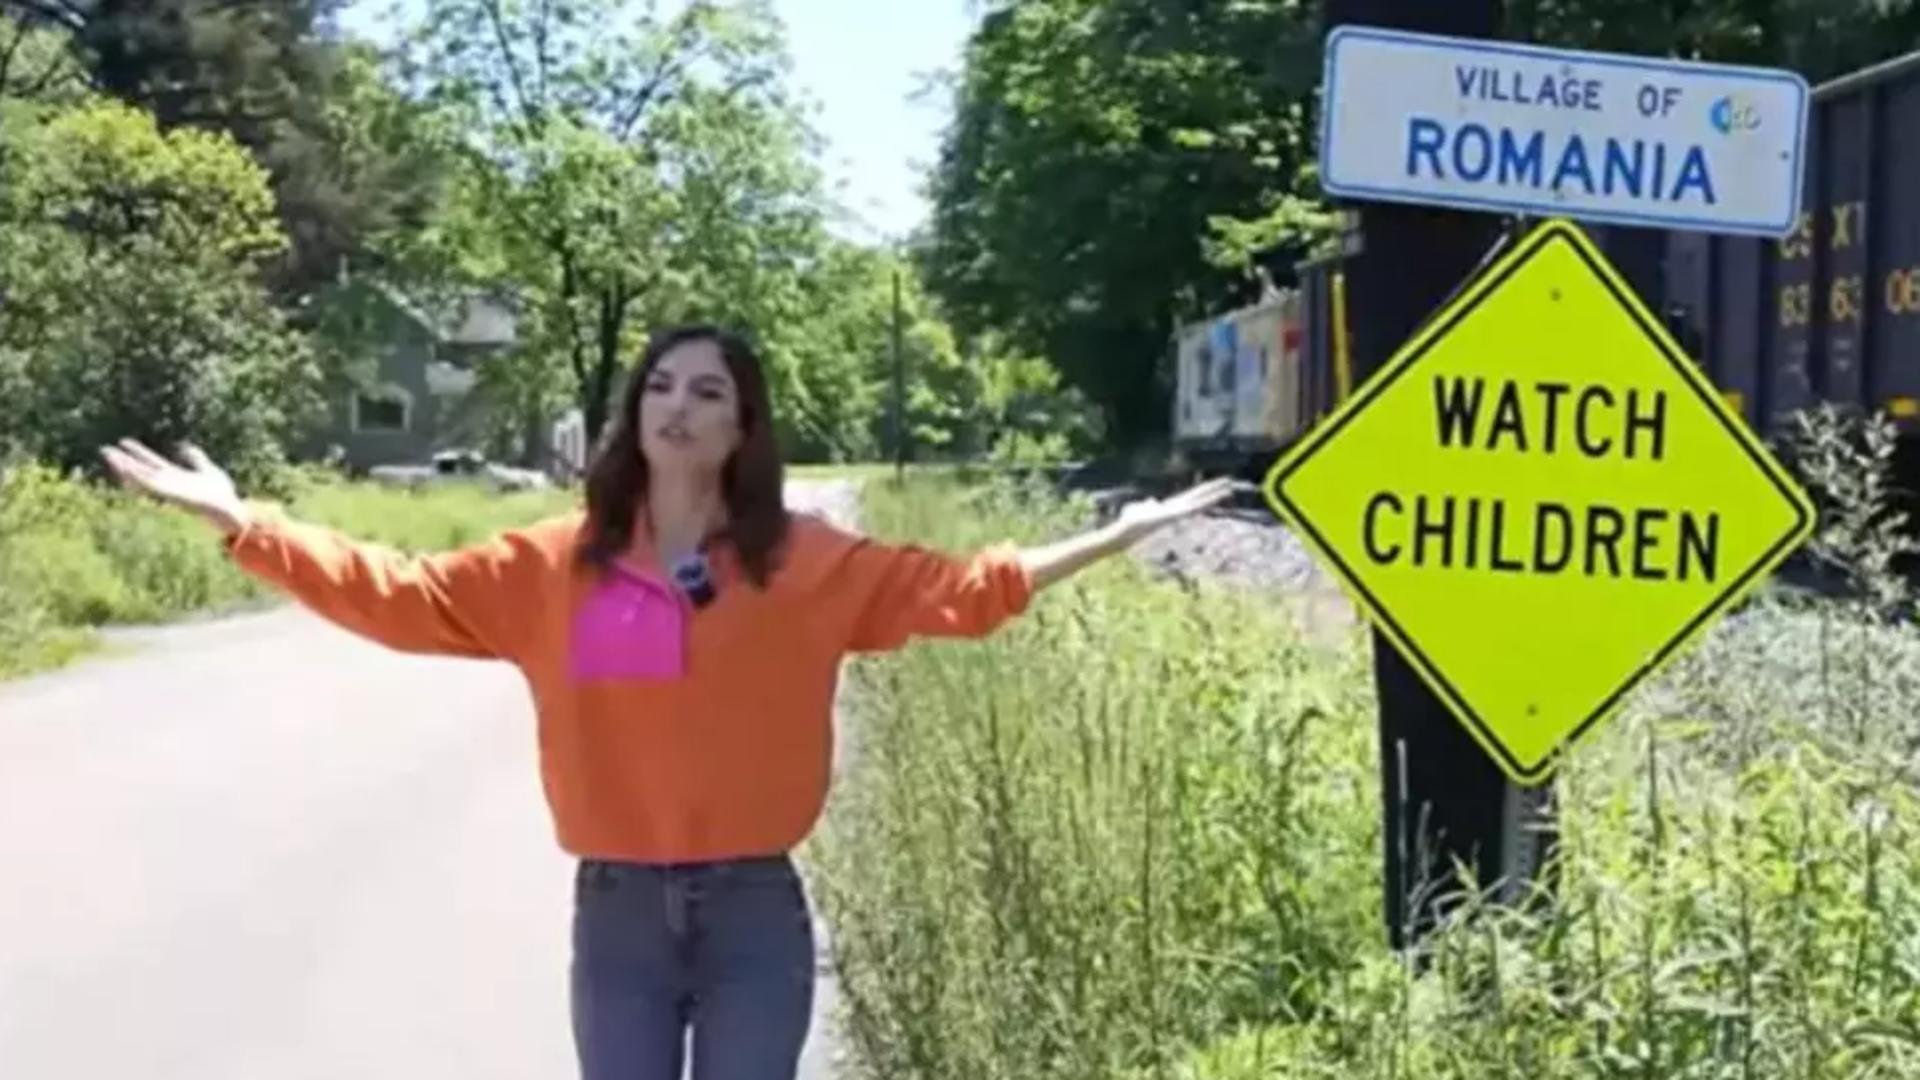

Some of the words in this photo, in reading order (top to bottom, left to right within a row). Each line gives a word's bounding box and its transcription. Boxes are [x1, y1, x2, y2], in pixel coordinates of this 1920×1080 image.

[1456, 66, 1602, 111] VILLAGE
[1637, 85, 1682, 117] OF
[1407, 119, 1716, 204] ROMANIA
[1434, 375, 1667, 460] WATCH
[1362, 491, 1719, 582] CHILDREN
